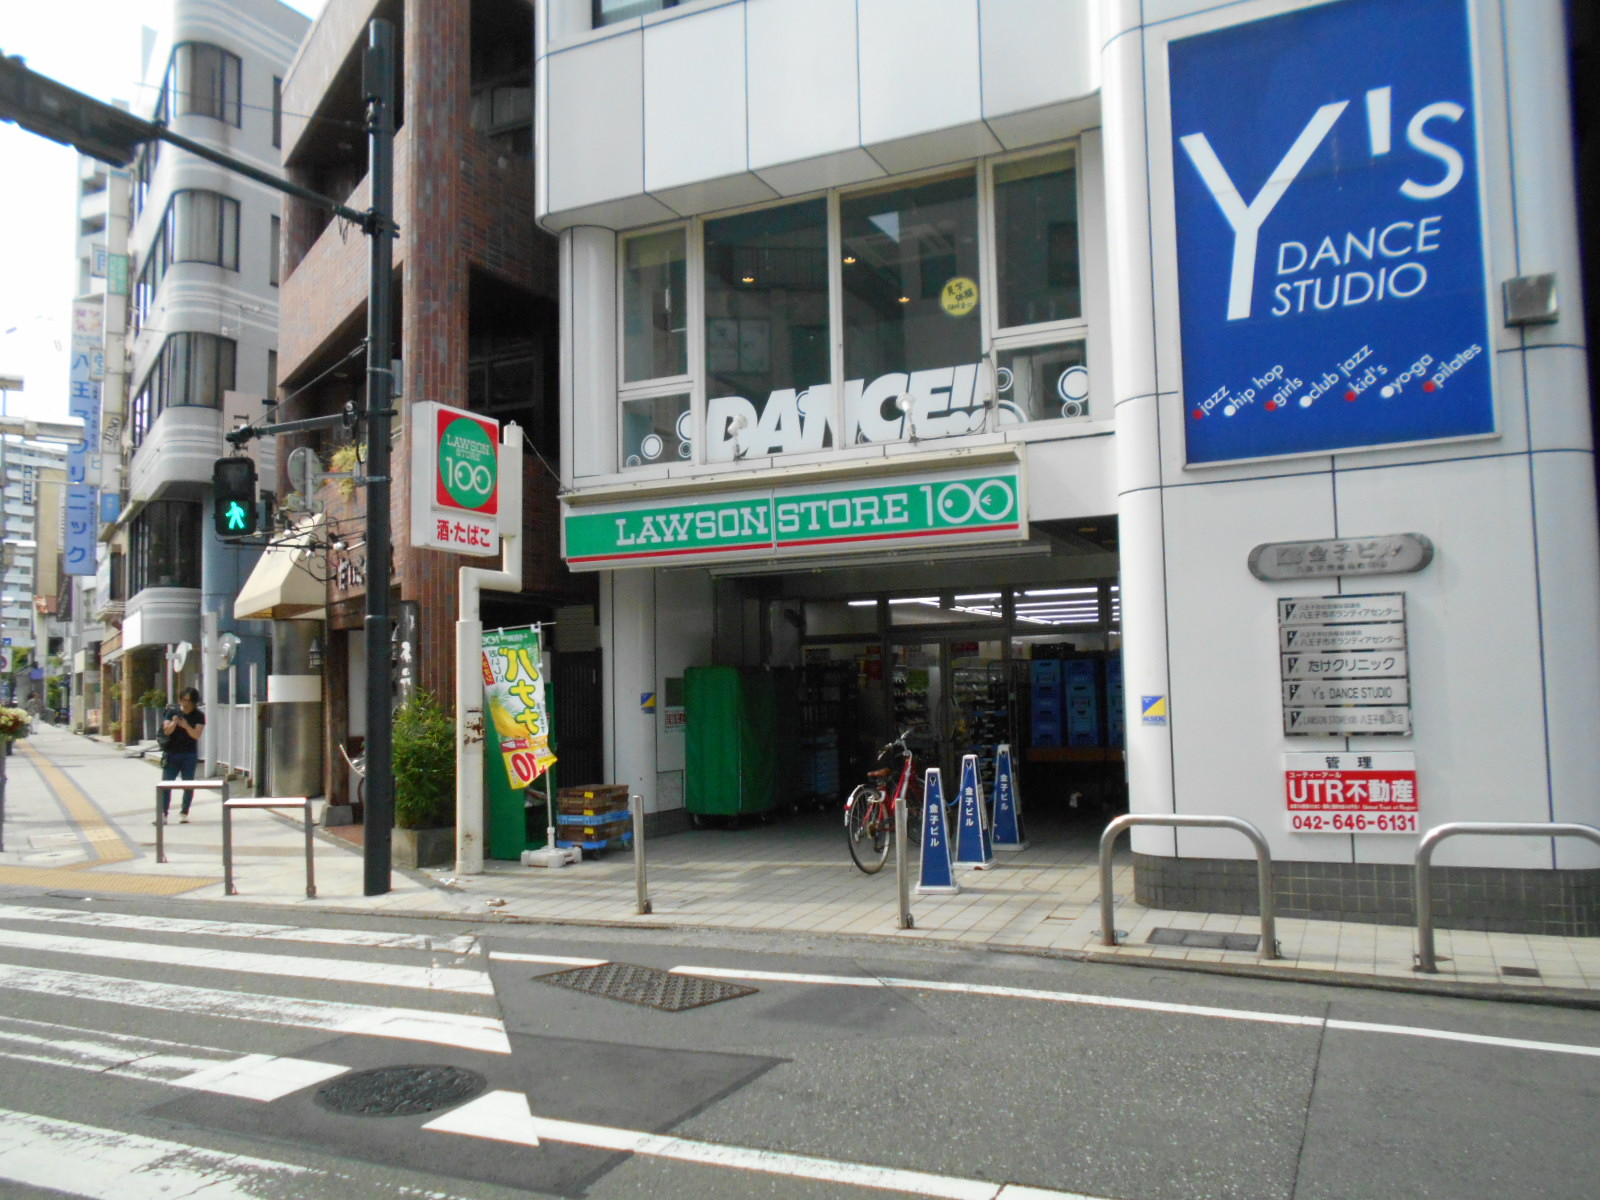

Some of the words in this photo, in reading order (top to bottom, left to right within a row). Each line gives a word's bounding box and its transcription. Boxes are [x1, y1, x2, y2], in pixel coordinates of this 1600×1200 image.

[1179, 86, 1465, 321] Y's
[1277, 216, 1442, 275] DANCE
[1271, 262, 1428, 316] STUDIO
[1309, 373, 1340, 399] club
[1337, 344, 1374, 377] jazz
[1348, 364, 1388, 395] kid's
[1390, 354, 1434, 394] yo-ga
[1431, 343, 1482, 388] pilates
[1199, 385, 1230, 416] jazz
[1228, 388, 1256, 410] hip
[1252, 365, 1284, 389] hop
[1273, 377, 1303, 407] girls
[103, 417, 120, 445] JUNO
[446, 433, 490, 456] LAWSON
[455, 447, 481, 462] STORE
[445, 456, 492, 495] 100
[616, 505, 768, 547] LAWSON
[776, 493, 909, 533] STORE
[919, 479, 1014, 527] 100
[436, 518, 492, 548] 酒・たばこ
[1308, 657, 1396, 672] たけクリニック
[1312, 686, 1325, 700] Y's
[1329, 687, 1359, 699] DANCE
[1361, 686, 1393, 699] STUDIO
[965, 786, 974, 827] 金子ビル
[1000, 773, 1009, 811] 金子ビル
[1289, 778, 1414, 803] UTR不動産
[929, 803, 940, 848] 金子ビル
[1292, 813, 1416, 831] 042-646-6131
